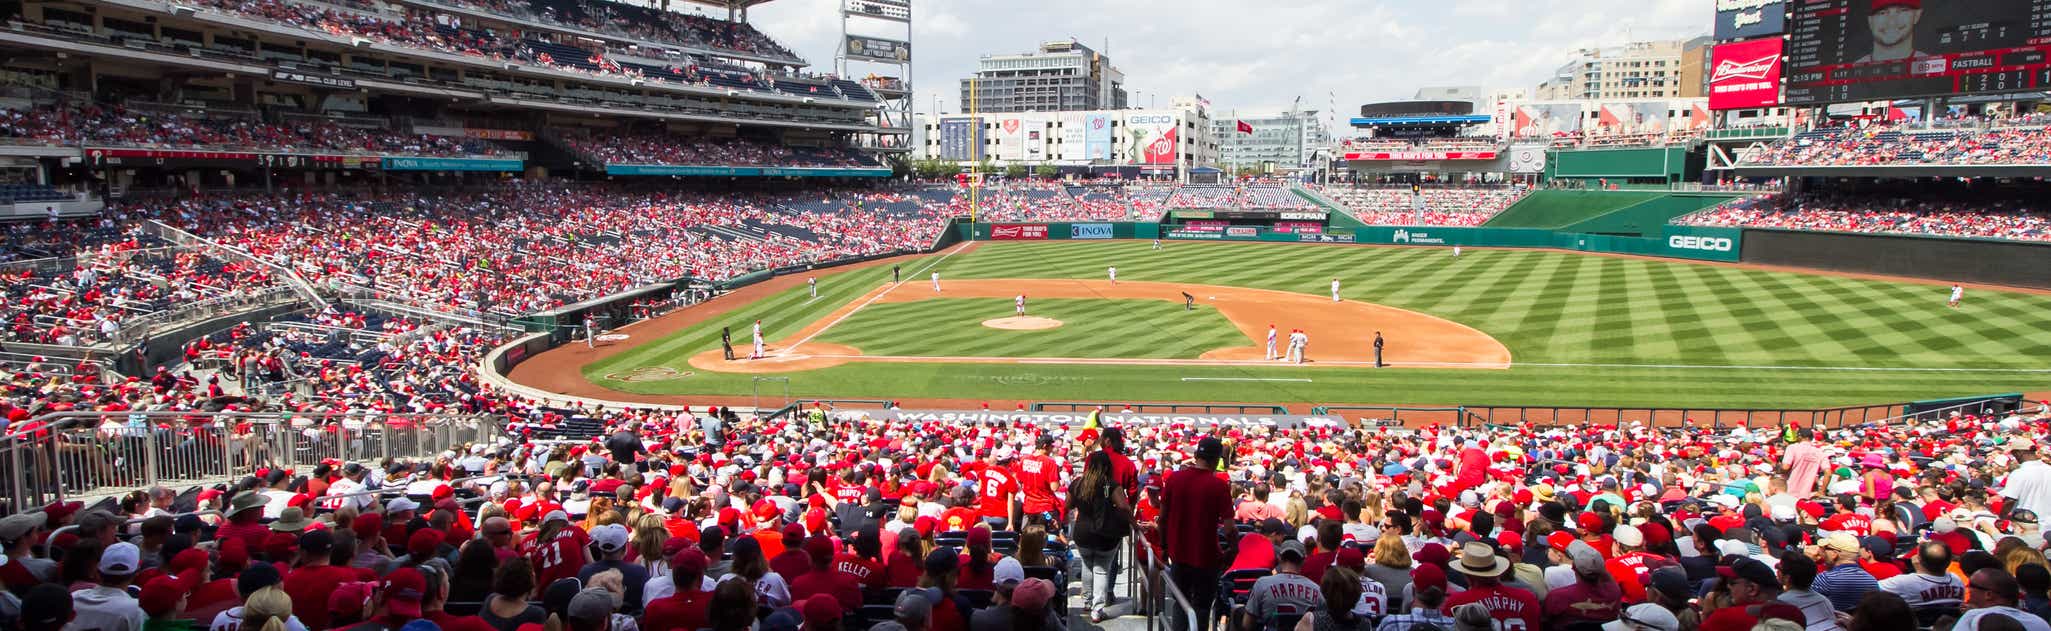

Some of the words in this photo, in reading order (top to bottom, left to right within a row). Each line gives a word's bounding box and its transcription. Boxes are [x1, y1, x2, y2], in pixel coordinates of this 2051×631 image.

[1952, 57, 1993, 69] FASTBALL
[1716, 63, 1770, 76] Budweiser
[1793, 74, 1809, 82] 2:15
[1981, 74, 1988, 82] 2
[1999, 73, 2006, 81] 0
[1980, 82, 1987, 91] 2
[1998, 81, 2005, 90] 0
[1130, 115, 1171, 124] GEICO
[393, 158, 418, 167] INOVA
[1082, 226, 1112, 235] INOVA
[1669, 235, 1732, 251] GEICO
[896, 412, 1089, 423] WASHINGTON
[1104, 415, 1276, 424] NATIONALS
[986, 479, 999, 497] 6
[1842, 518, 1868, 530] HARPER
[1619, 555, 1643, 568] TURN
[838, 560, 871, 579] KELLEY
[1270, 583, 1319, 606] HARPER
[1920, 586, 1964, 602] HARPER
